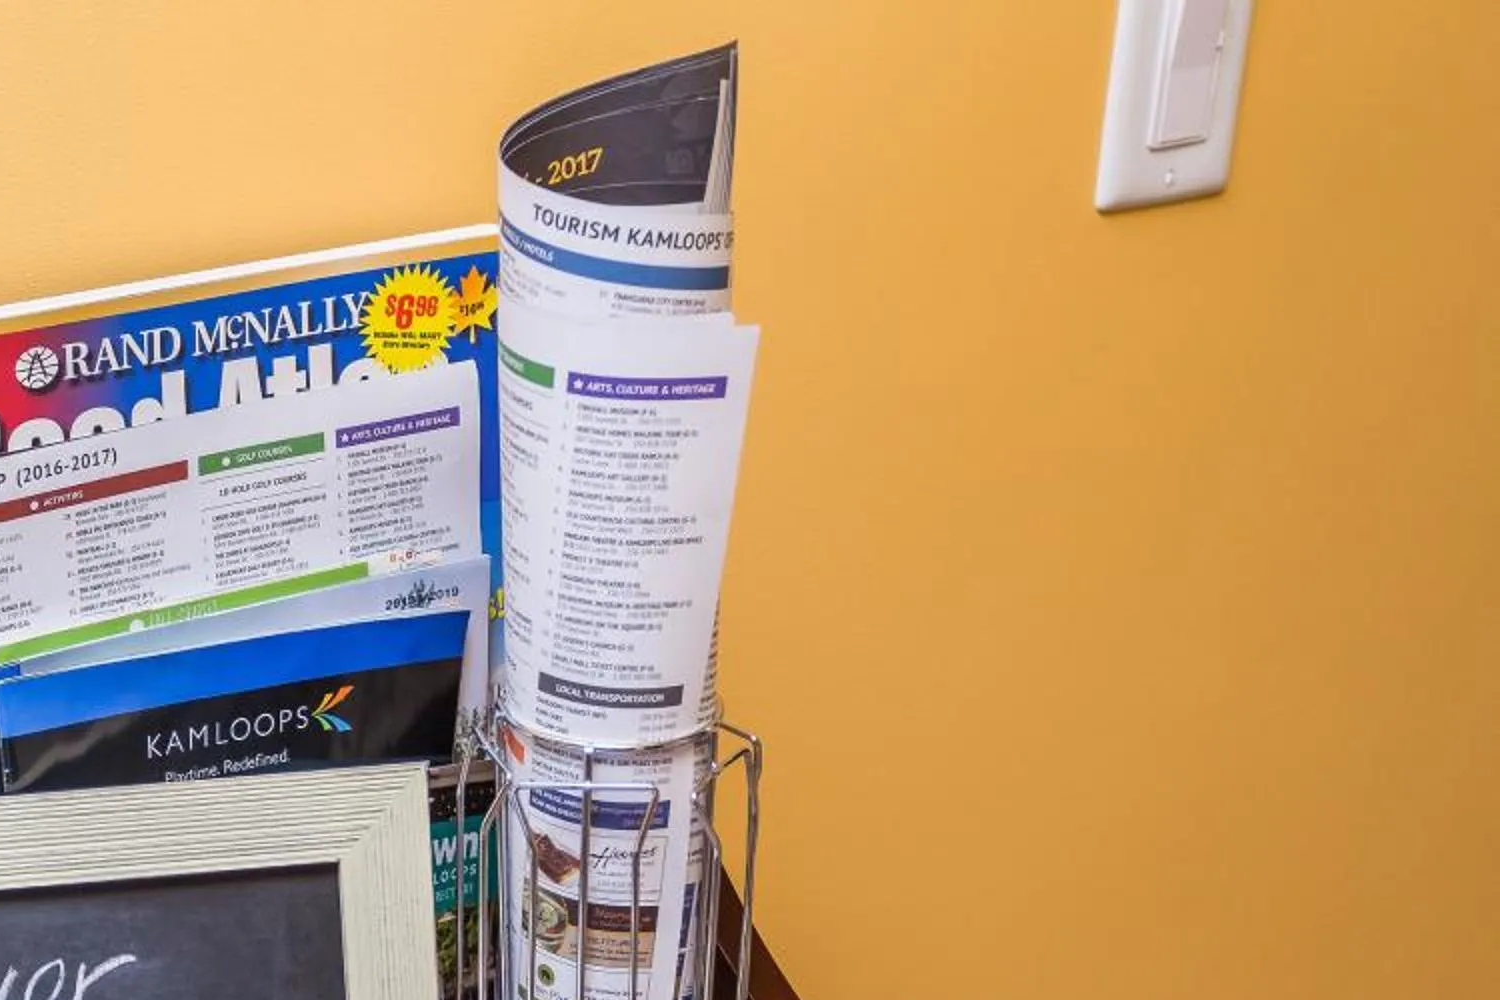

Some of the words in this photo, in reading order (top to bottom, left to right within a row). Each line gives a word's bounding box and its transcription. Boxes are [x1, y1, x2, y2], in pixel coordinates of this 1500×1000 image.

[548, 147, 603, 185] 2017
[532, 203, 621, 243] TOURISM
[62, 326, 181, 381] RAND
[661, 384, 669, 395] &
[671, 383, 716, 395] HERITAGE
[16, 448, 118, 488] (2016-2017)
[555, 683, 583, 699] LOCAL
[585, 687, 665, 704] TRANSPORTATION
[147, 705, 309, 759] KAMLOOPS
[223, 748, 291, 774] Redefined.
